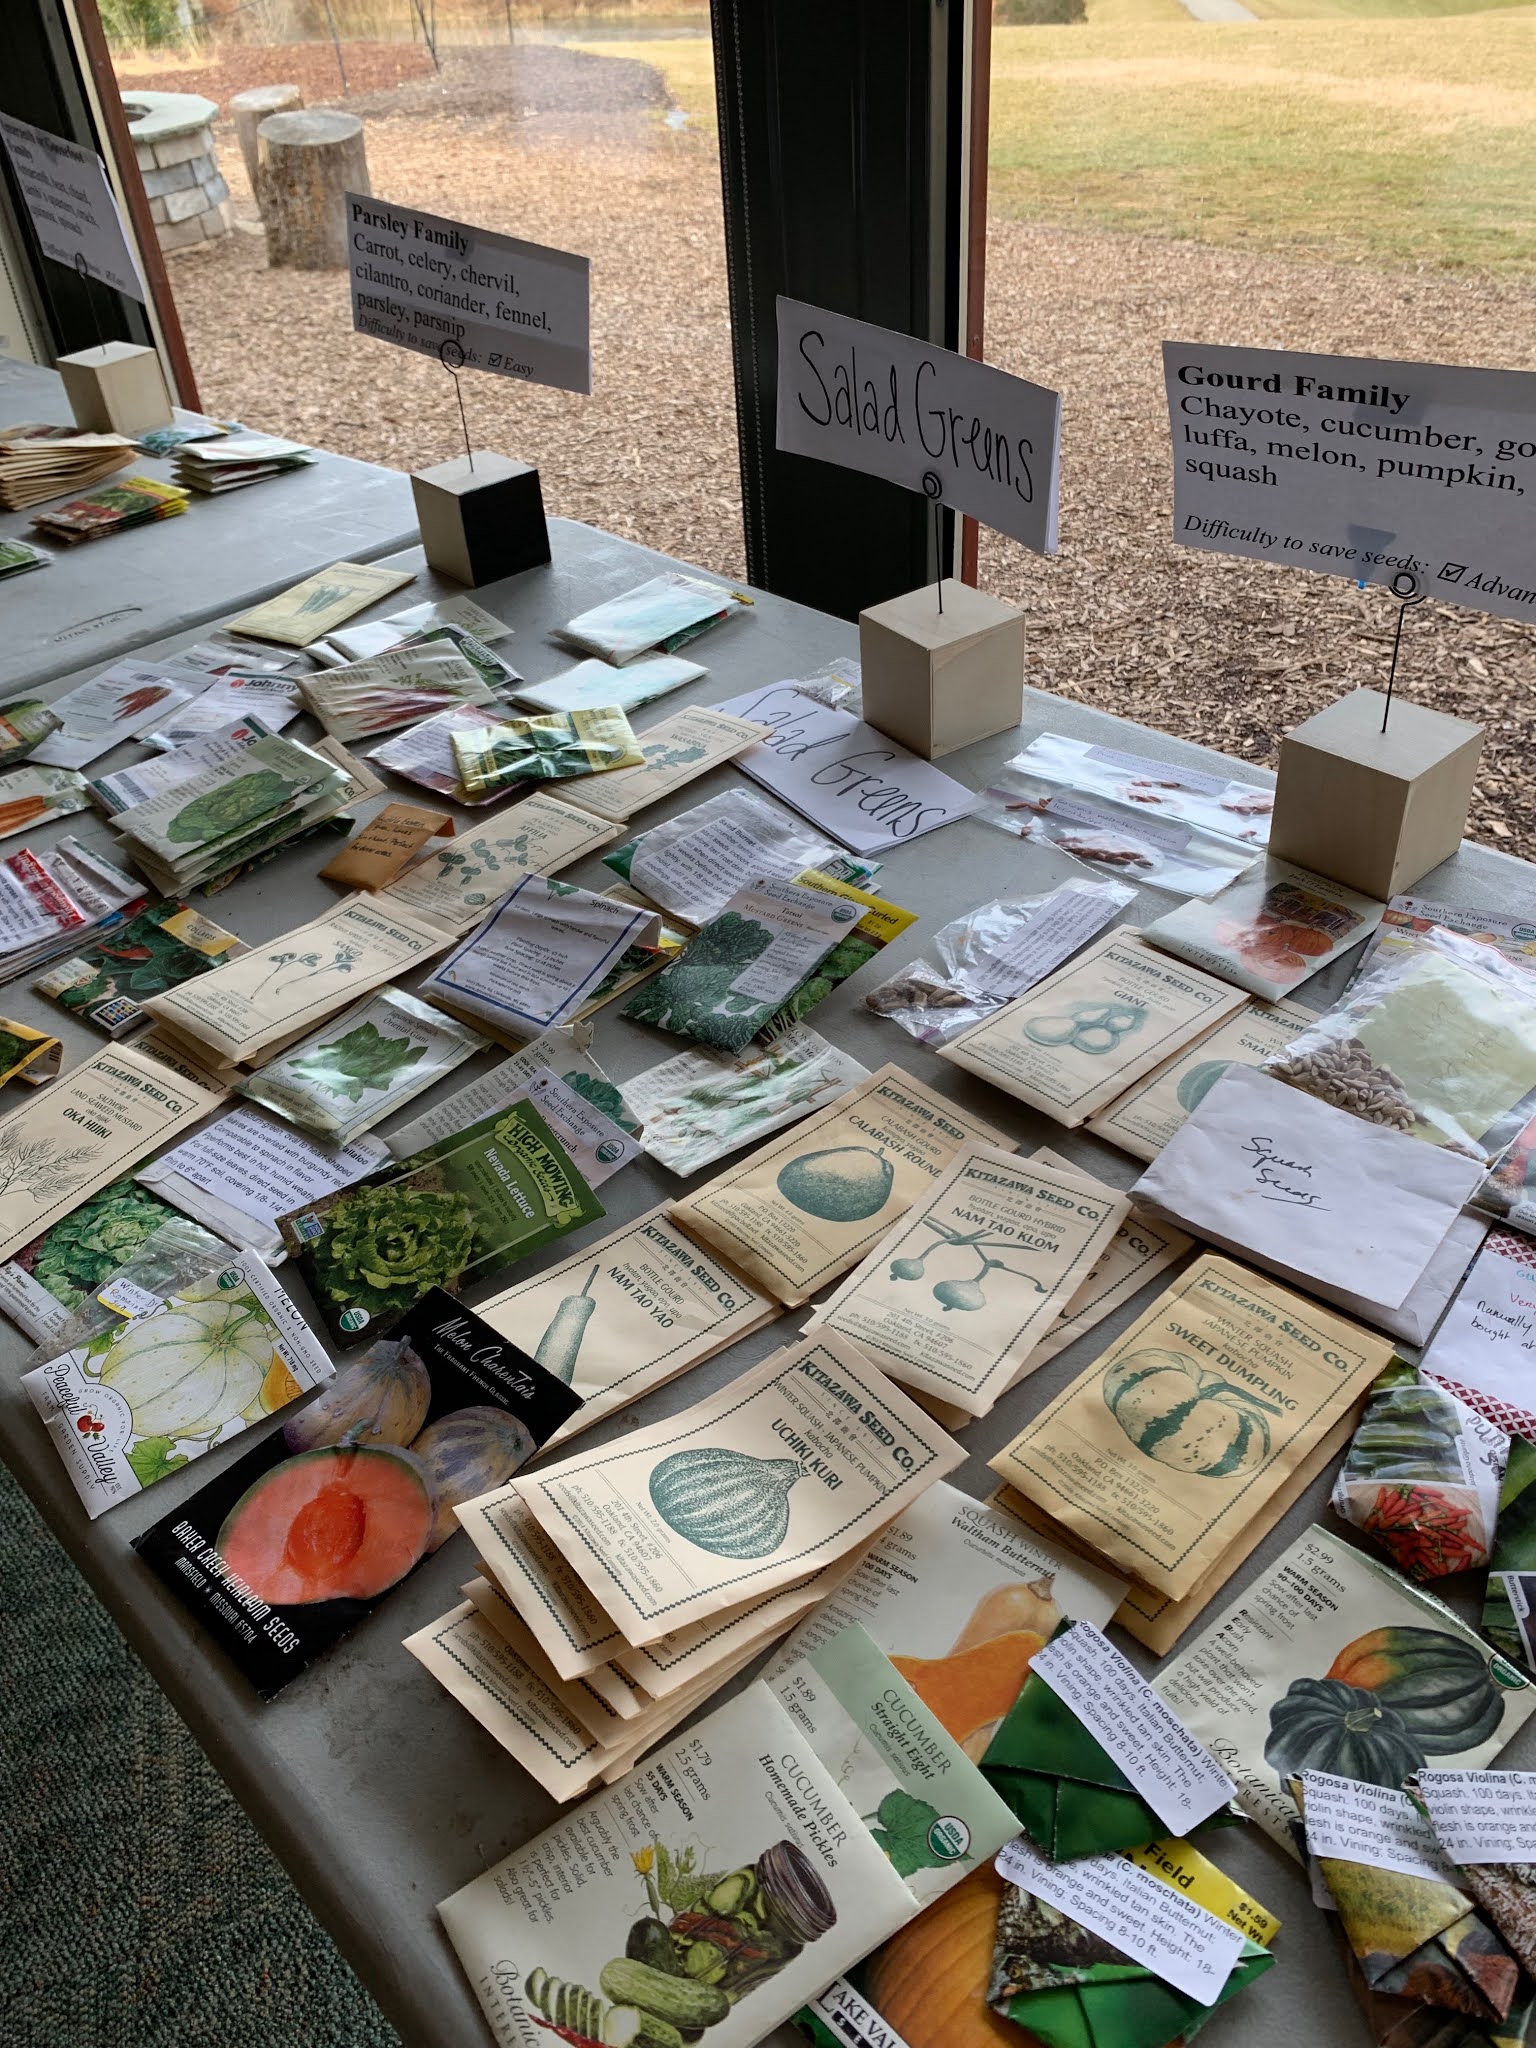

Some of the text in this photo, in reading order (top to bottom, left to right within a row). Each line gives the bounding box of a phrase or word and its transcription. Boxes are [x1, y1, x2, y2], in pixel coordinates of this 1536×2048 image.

[352, 204, 469, 256] Parsley Family
[353, 233, 520, 297] Carrot, celery, chervil,
[355, 262, 552, 334] cilantro, coriander, fennel,
[357, 293, 465, 339] parsley, parsnip
[358, 314, 534, 376] Difficulty to Easy
[1177, 365, 1411, 414] Gourd Family
[798, 331, 1035, 504] Salad Greens
[1180, 395, 1484, 456] Chayote, cucumber,
[1183, 424, 1525, 496] luffa, melon, pumpkin,
[1185, 456, 1279, 487] squash
[1183, 514, 1429, 575] Difficulty to save seeds:
[811, 750, 946, 837] Greens
[186, 923, 216, 942] COLLARDS
[344, 911, 388, 932] KITAZAWA
[386, 928, 410, 942] SEED
[589, 898, 620, 916] Spinach
[1104, 951, 1162, 978] KITAZAWA
[1161, 975, 1194, 993] SEED
[1113, 990, 1149, 1008] GIANT
[91, 1062, 143, 1088] KITAZAWA
[140, 1083, 168, 1102] SEED
[62, 1107, 112, 1139] OKA HIJIKI
[540, 1095, 585, 1136] Seed Exchange
[549, 1087, 605, 1137] Southern Exposure
[876, 1086, 966, 1140] KITAZAWA SEED
[213, 1124, 315, 1184] Comparable spinach flavor
[507, 1123, 574, 1208] HIGH MOWING
[848, 1115, 943, 1178] CALABASH ROUND
[1241, 1136, 1312, 1178] Squash
[483, 1147, 535, 1219] Nevada Lettuce
[963, 1168, 1034, 1194] KITAZAWA
[1035, 1189, 1075, 1210] SEED
[951, 1207, 1060, 1254] NAM TAO KLOM
[639, 1263, 684, 1305] BOTTLE GOURD
[641, 1225, 736, 1311] KITAZAWA SEED CO.
[606, 1266, 674, 1328] NAM TAO YAO
[432, 1317, 473, 1351] Melon
[1198, 1279, 1349, 1373] KITAZAWA SEED CO.
[1201, 1319, 1294, 1380] JAPANESE PUMPKIN
[1217, 1315, 1294, 1368] WINTER SQUASH
[1165, 1322, 1299, 1411] SWEET DUMPLING
[44, 1363, 117, 1484] Peaceful Valley
[774, 1379, 824, 1430] WINTER SQUASH
[798, 1360, 915, 1472] KITAZAWA SEED CO.
[771, 1418, 844, 1490] UCHIKI KURI
[804, 1429, 833, 1459] kabocha
[75, 1459, 95, 1490] SUPPLY
[884, 1539, 918, 1561] grams
[951, 1516, 1056, 1579] Waltham Butternut
[958, 1505, 1063, 1571] SQUASH WINTER
[1304, 1543, 1335, 1565] $2.99
[172, 1520, 300, 1654] BAKER CREEK HEIRLOOM SEEDS
[861, 1560, 893, 1580] 100 DAYS
[867, 1551, 919, 1584] WARM SEASON
[1283, 1565, 1339, 1612] WARM SEASON
[1297, 1552, 1346, 1593] 1.5 grams
[174, 1556, 258, 1644] MANSFIELD MISSOURI 65704
[1303, 1593, 1325, 1612] DAYS
[792, 1676, 817, 1702] $1.89
[1071, 1667, 1102, 1700] orange
[780, 1685, 817, 1734] 1.5 grams
[883, 1689, 951, 1775] CUCUMBER
[1082, 1701, 1118, 1744] Spacing
[689, 1738, 713, 1767] $1.79
[871, 1702, 936, 1780] Straight Eight
[1152, 1701, 1230, 1790] moschata) Winter
[645, 1770, 668, 1802] 55 DAYS
[655, 1763, 695, 1822] WARM SEASON
[675, 1749, 711, 1801] 2.5 grams
[1417, 1770, 1506, 1784] Rogosa Violina
[1472, 1788, 1493, 1798] 100
[759, 1754, 838, 1868] Homemade Pickles
[781, 1755, 847, 1847] CUCUMBER
[1143, 1843, 1195, 1889] Field
[1138, 1871, 1243, 1944] moschata) Winter
